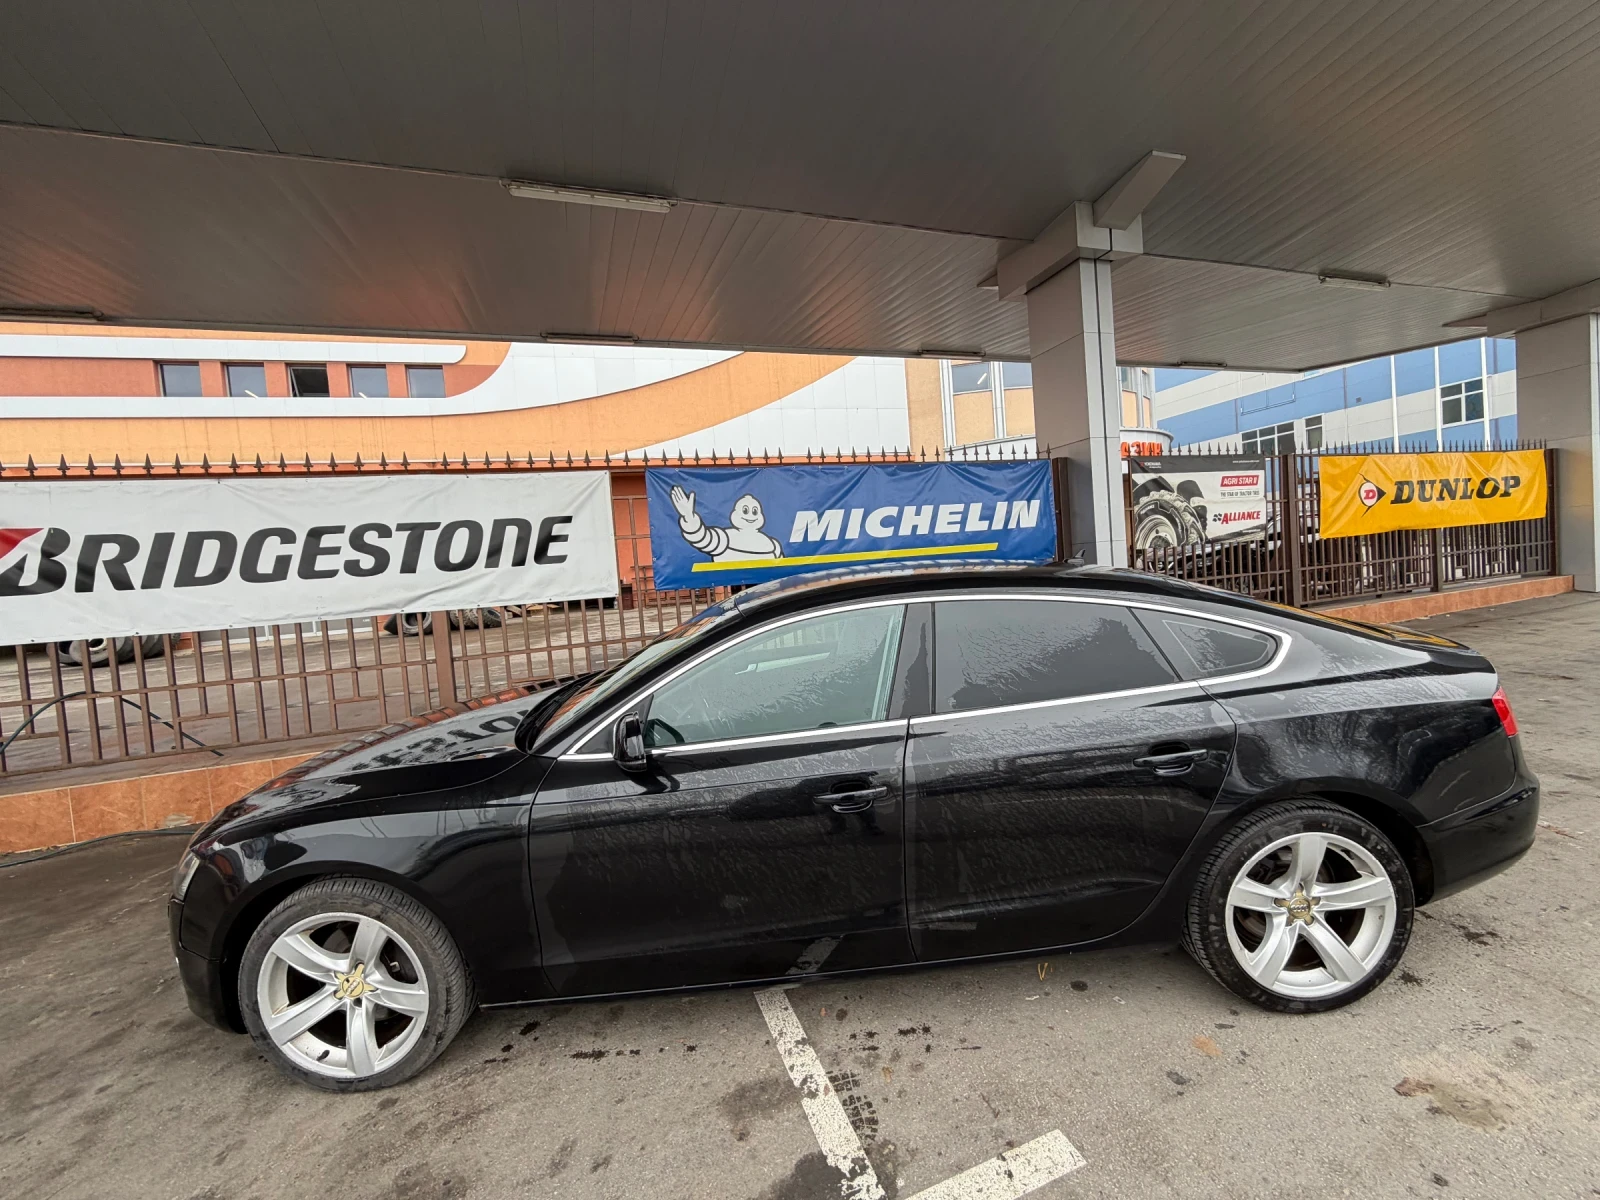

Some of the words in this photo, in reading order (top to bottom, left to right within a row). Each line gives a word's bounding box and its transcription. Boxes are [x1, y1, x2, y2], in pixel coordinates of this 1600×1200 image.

[1223, 477, 1238, 485] AGRI
[1363, 489, 1377, 500] D
[1390, 475, 1521, 504] DUNLOP
[789, 500, 1041, 543] MICHELIN
[1221, 510, 1261, 524] ALLIANCE
[0, 516, 573, 597] BRIDGESTONE
